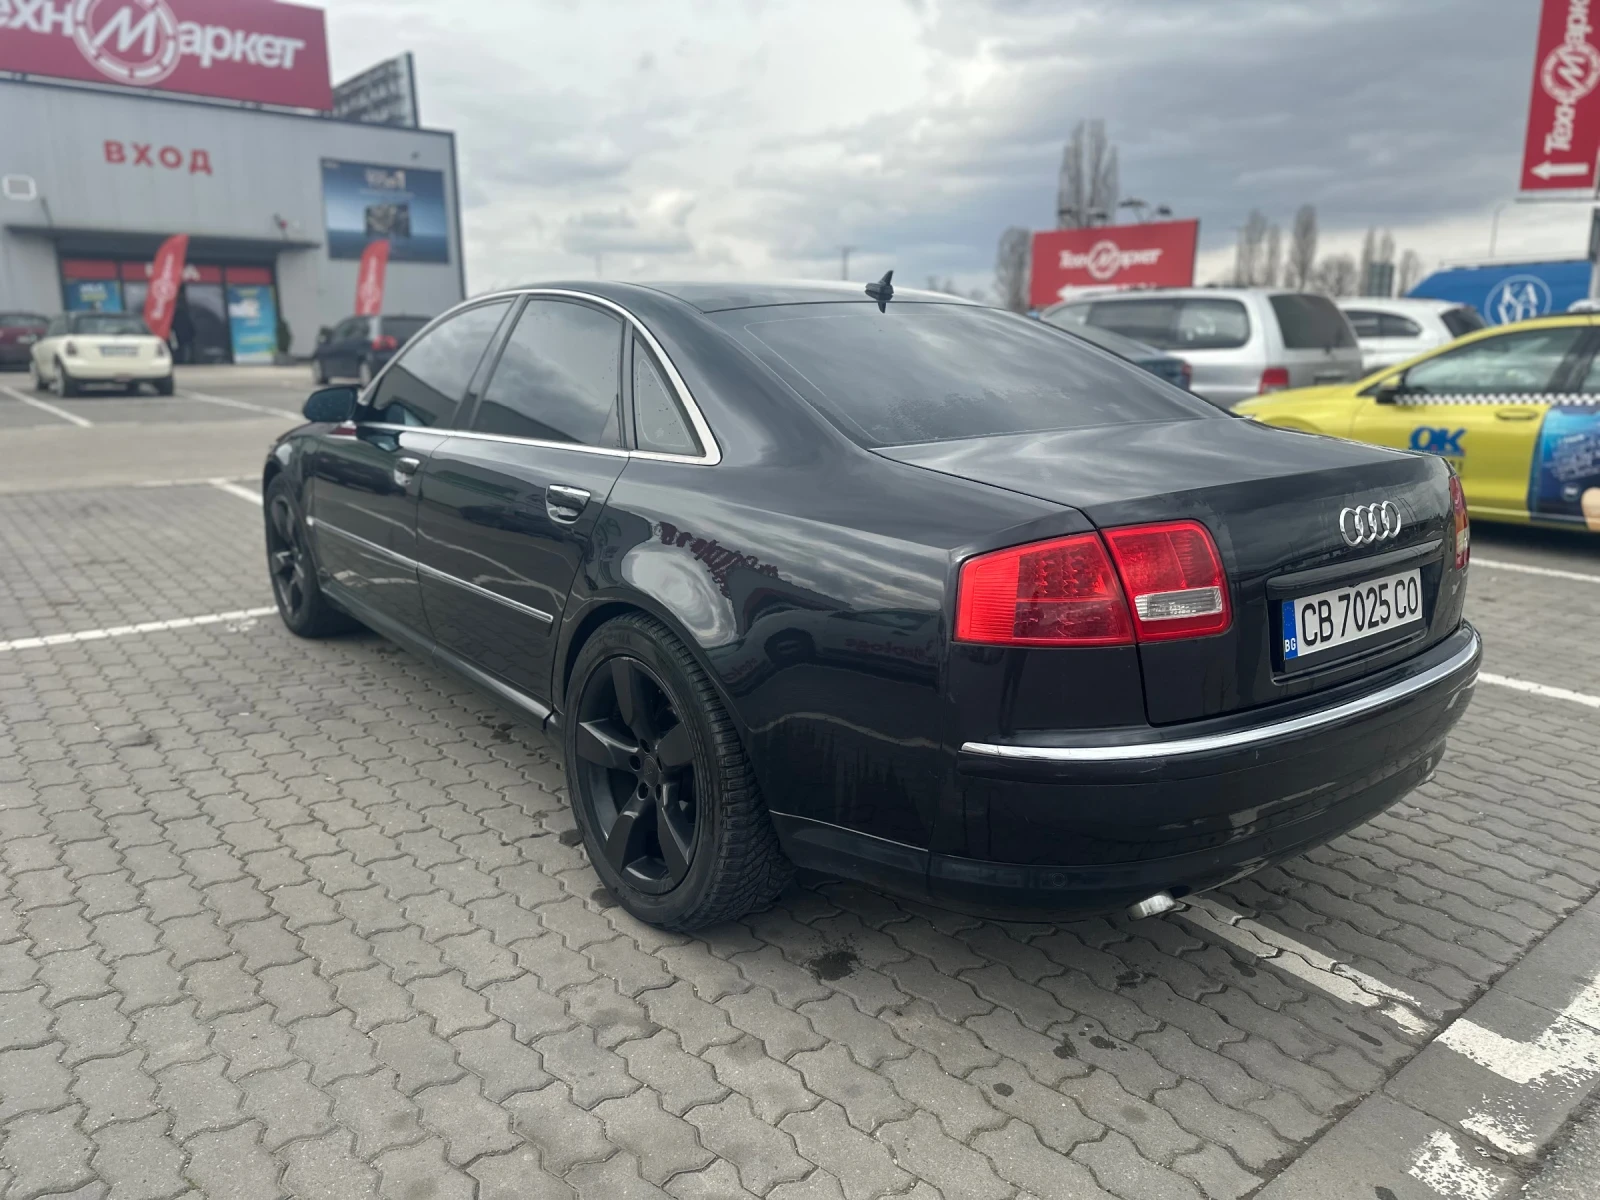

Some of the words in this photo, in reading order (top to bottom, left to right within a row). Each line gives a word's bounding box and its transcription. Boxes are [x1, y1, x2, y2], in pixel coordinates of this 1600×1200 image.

[103, 139, 213, 175] ВХОД
[1409, 425, 1467, 451] OK
[1284, 637, 1297, 653] BG
